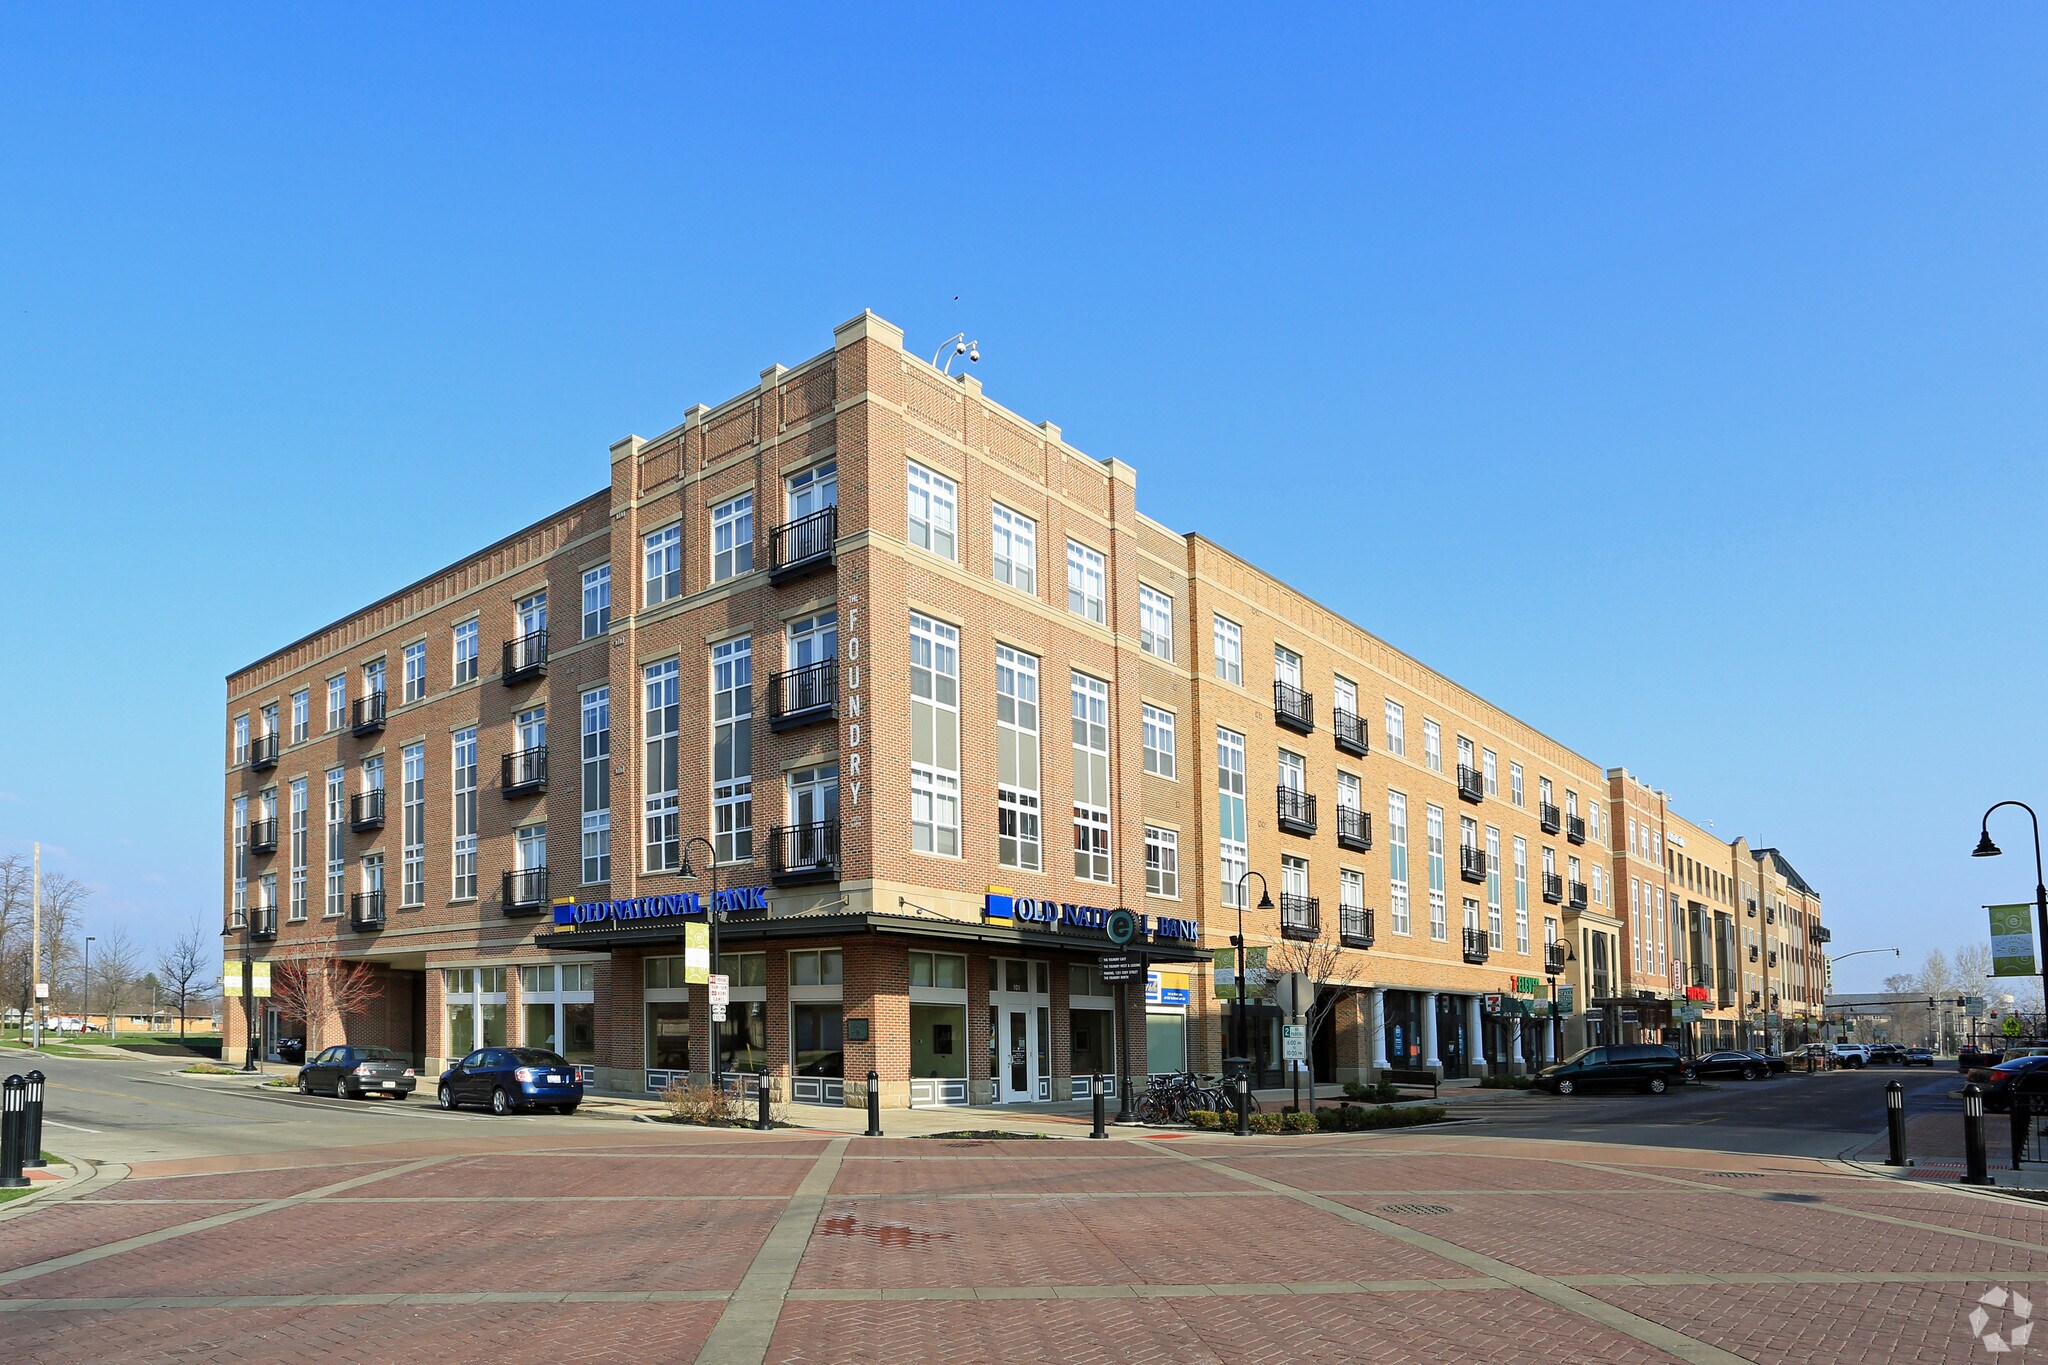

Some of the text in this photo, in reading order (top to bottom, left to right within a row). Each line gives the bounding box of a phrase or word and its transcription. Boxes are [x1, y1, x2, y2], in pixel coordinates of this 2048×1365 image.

[848, 594, 859, 603] THE
[848, 608, 861, 805] FOUNDRY
[574, 886, 768, 924] OLD NATIONAL BANK
[1016, 897, 1200, 941] OLD NATIL BANK
[1284, 1027, 1290, 1036] 2
